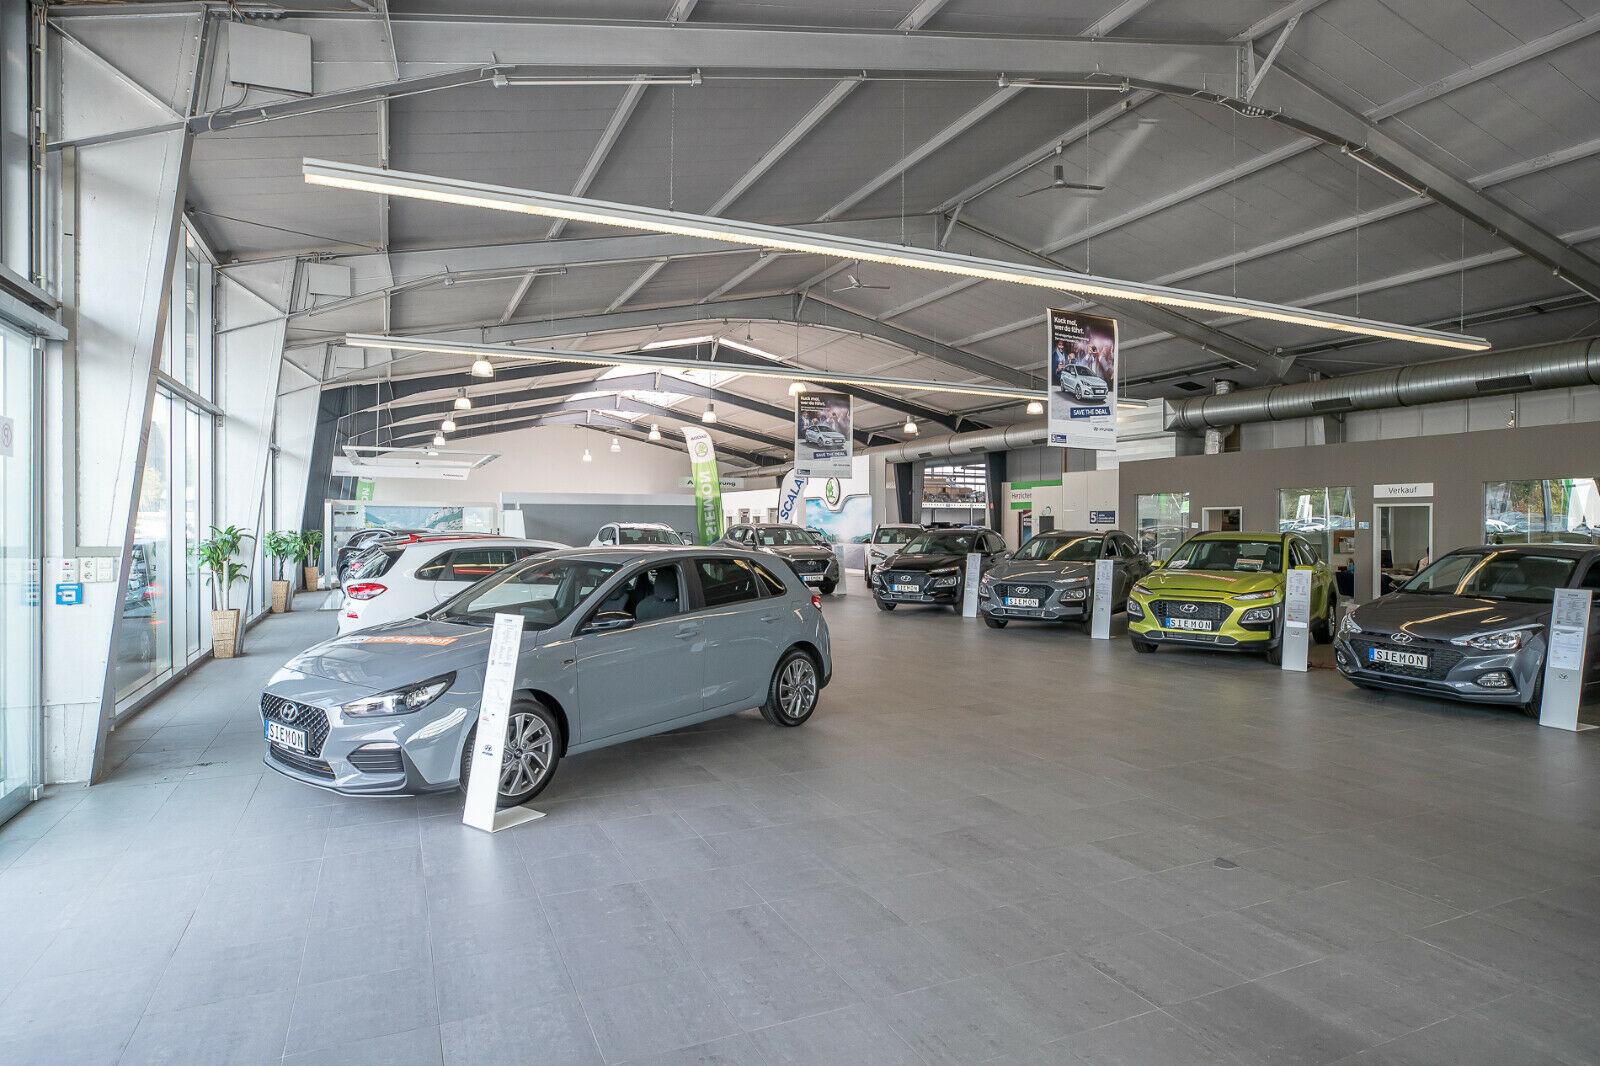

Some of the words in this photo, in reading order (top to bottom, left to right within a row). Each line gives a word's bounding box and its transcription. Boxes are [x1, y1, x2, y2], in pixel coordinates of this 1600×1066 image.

[1388, 486, 1418, 494] Verkauf
[780, 478, 804, 520] SCALA
[1090, 511, 1097, 523] 5
[1009, 598, 1038, 606] SIEMON
[1170, 619, 1211, 629] SIEMON
[1376, 650, 1424, 666] SIEMON
[269, 723, 304, 748] SIEMON
